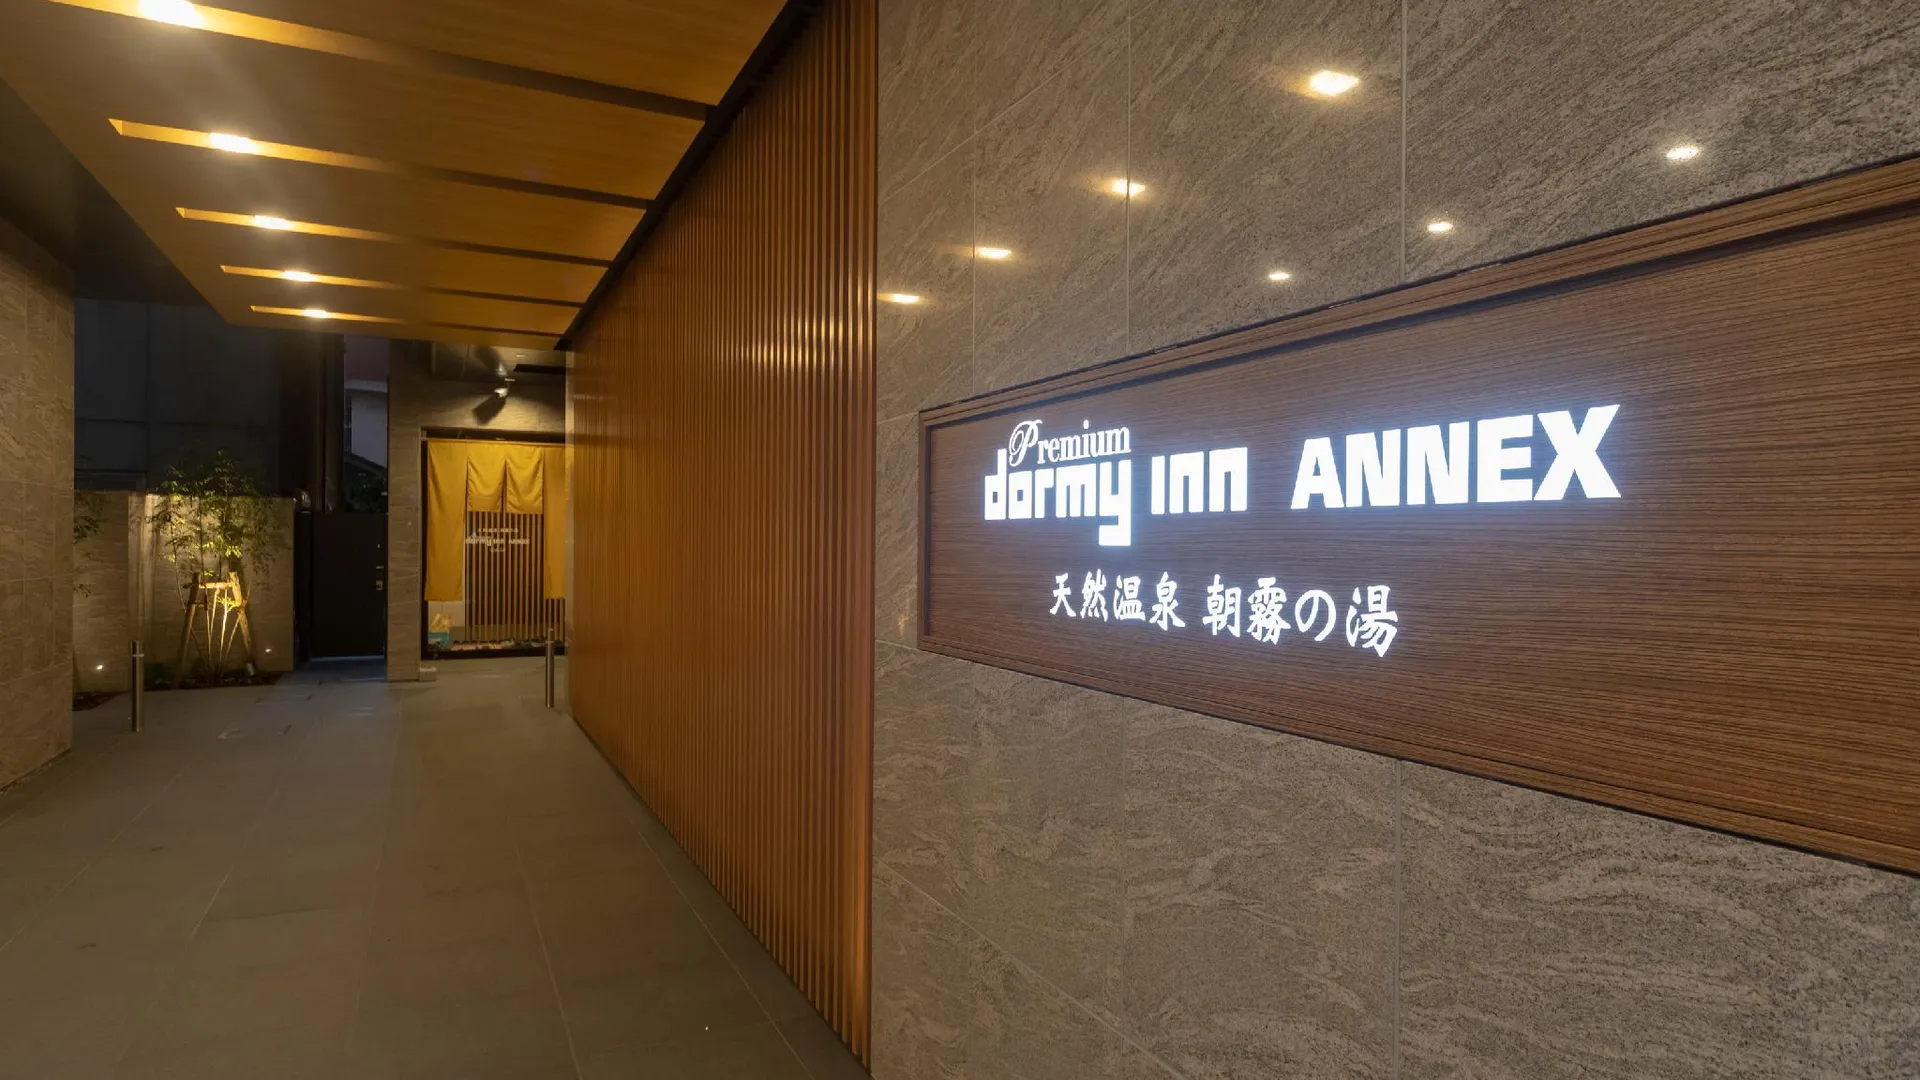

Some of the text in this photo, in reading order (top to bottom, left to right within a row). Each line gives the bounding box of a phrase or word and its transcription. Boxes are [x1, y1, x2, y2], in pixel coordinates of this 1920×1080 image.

[984, 447, 1132, 547] dormy
[1290, 404, 1622, 510] ANNEX
[1008, 419, 1132, 467] Premium
[1049, 568, 1399, 658] 天然温泉 朝霧の湯
